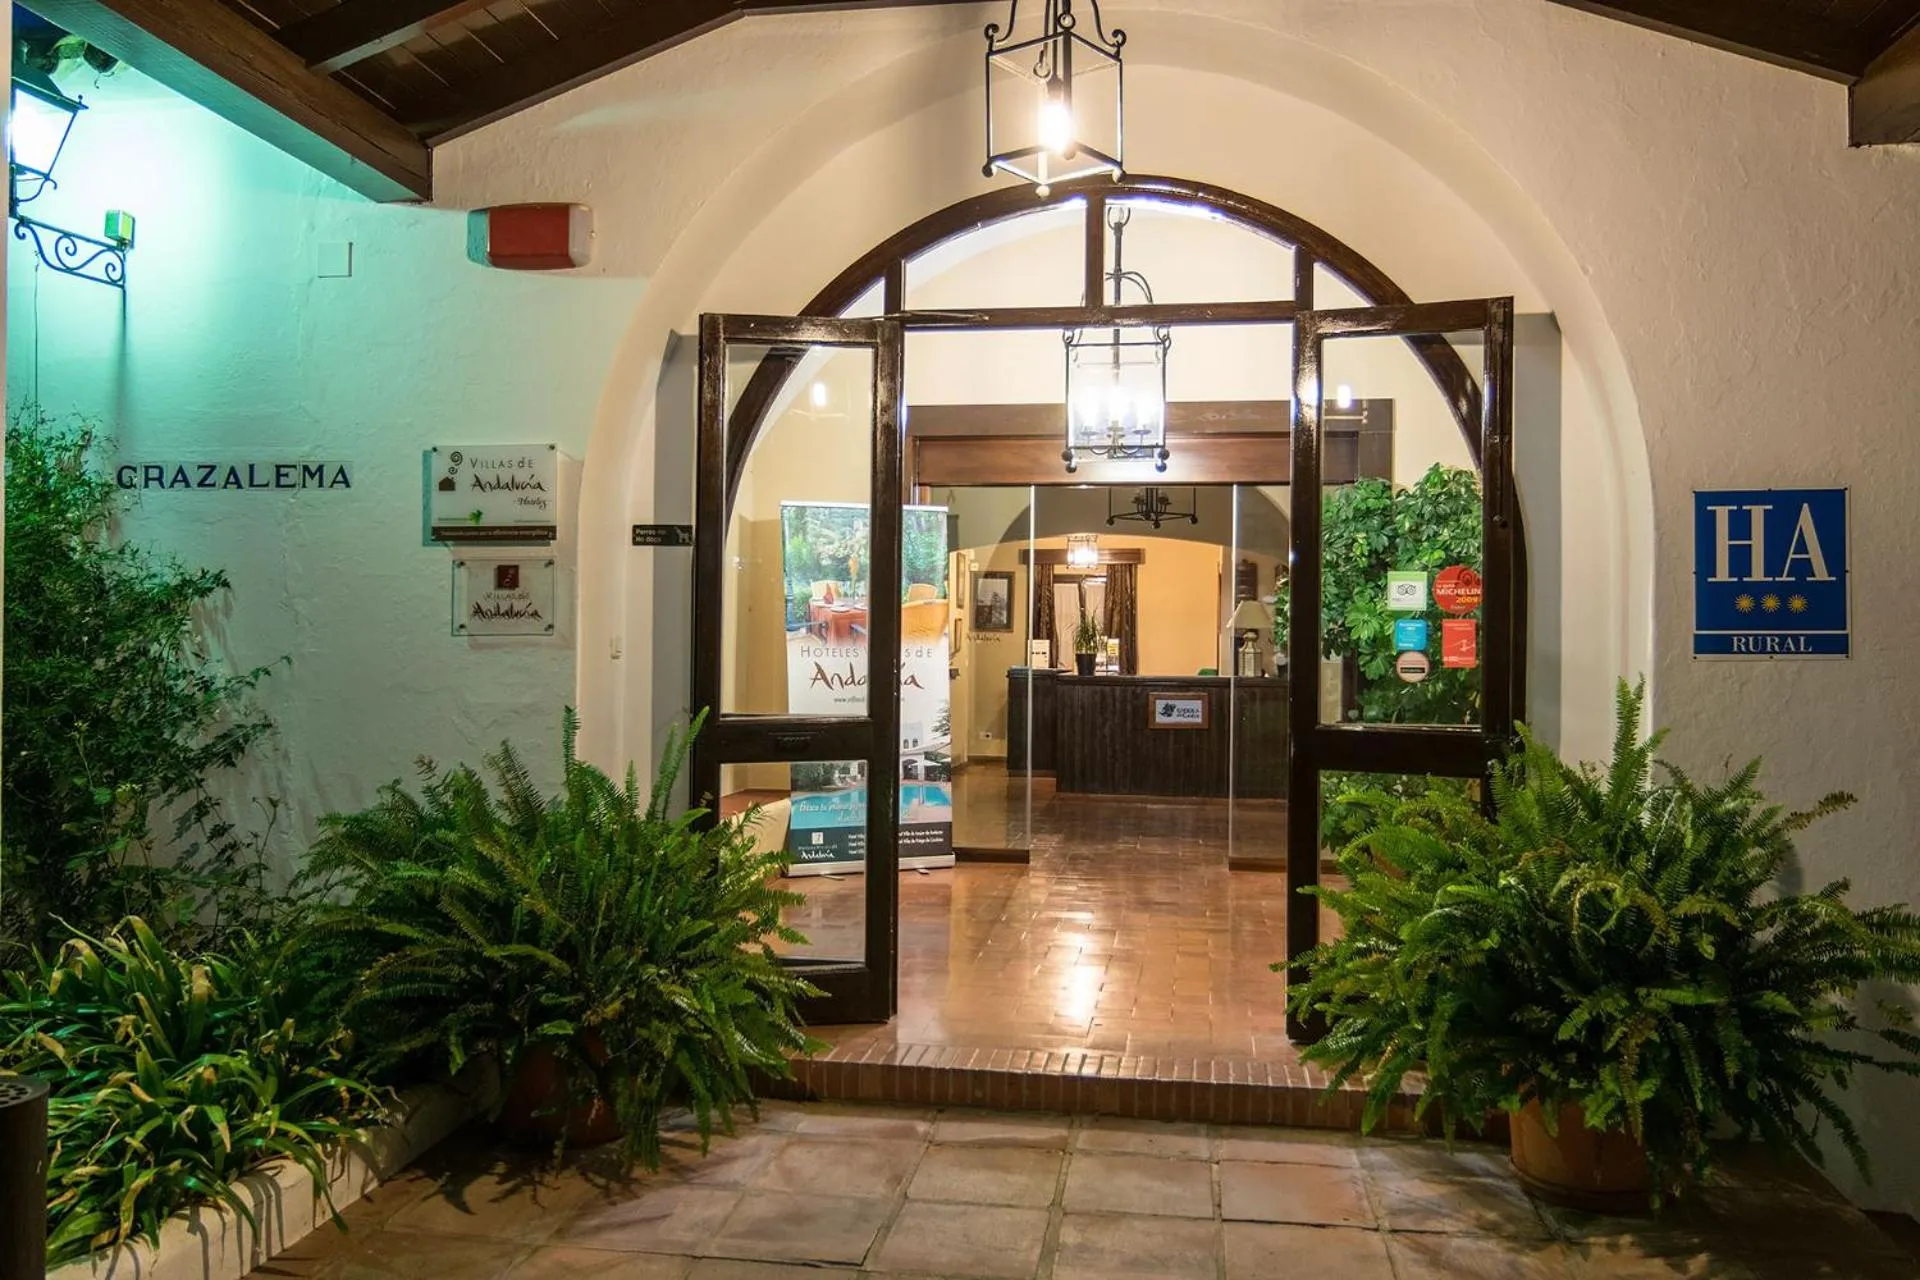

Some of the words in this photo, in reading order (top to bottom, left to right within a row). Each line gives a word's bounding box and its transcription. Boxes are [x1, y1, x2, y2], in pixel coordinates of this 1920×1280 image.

[470, 458, 513, 469] VILLAS
[116, 463, 352, 490] GRAZALEMA
[472, 474, 547, 492] Andalucía
[1706, 502, 1837, 582] HA
[1435, 588, 1481, 596] MICHELIN
[800, 646, 860, 658] HOTELES
[1732, 636, 1813, 653] RURAL
